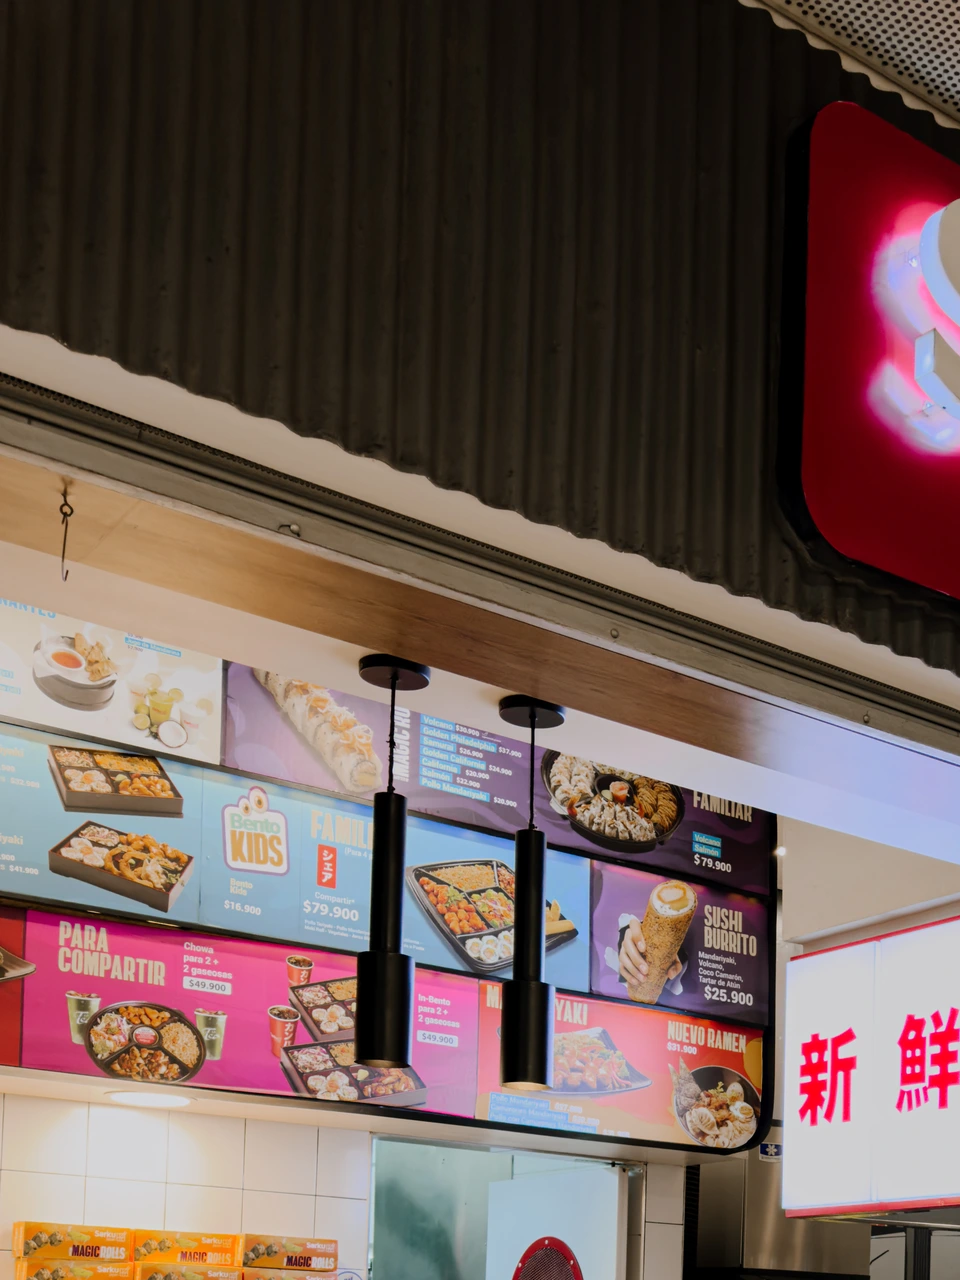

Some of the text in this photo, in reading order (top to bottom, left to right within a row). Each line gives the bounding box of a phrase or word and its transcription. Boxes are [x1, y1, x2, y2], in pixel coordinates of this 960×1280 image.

[455, 724, 480, 737] $30.900
[450, 734, 496, 753] Philadelphia
[693, 790, 753, 823] FAMILIAR
[229, 813, 281, 834] Bento
[694, 833, 721, 847] Volcano
[230, 829, 284, 867] KIDS
[229, 878, 253, 889] Bento
[229, 885, 247, 896] Kids
[223, 900, 262, 916] $16.900
[303, 899, 359, 922] $79.900
[704, 904, 743, 933] SUSHI
[58, 921, 109, 953] PARA
[703, 927, 757, 957] BURRITO
[183, 942, 214, 954] Chowa
[183, 954, 212, 966] para 2
[698, 951, 737, 965] Mandariyaki,
[698, 959, 724, 971] Volcano,
[58, 947, 166, 987] COMPARTIR
[183, 965, 233, 980] 2 gaseosas
[698, 967, 714, 977] Coco
[188, 979, 227, 992] $49.900
[698, 976, 716, 985] Tartar
[717, 979, 726, 987] de
[418, 993, 451, 1006] In-Bento
[704, 985, 753, 1006] $25.900
[417, 1005, 442, 1016] para 2
[418, 1014, 460, 1029] 2 gaseosas
[421, 1032, 454, 1045] $49.900
[667, 1020, 746, 1054] NUEVO RAMEN
[667, 1041, 697, 1055] $31.900
[71, 1244, 125, 1259] MAGIC ROLLS
[180, 1251, 232, 1264] MAGIC ROLLS
[286, 1255, 335, 1269] MAGIC ROLLS
